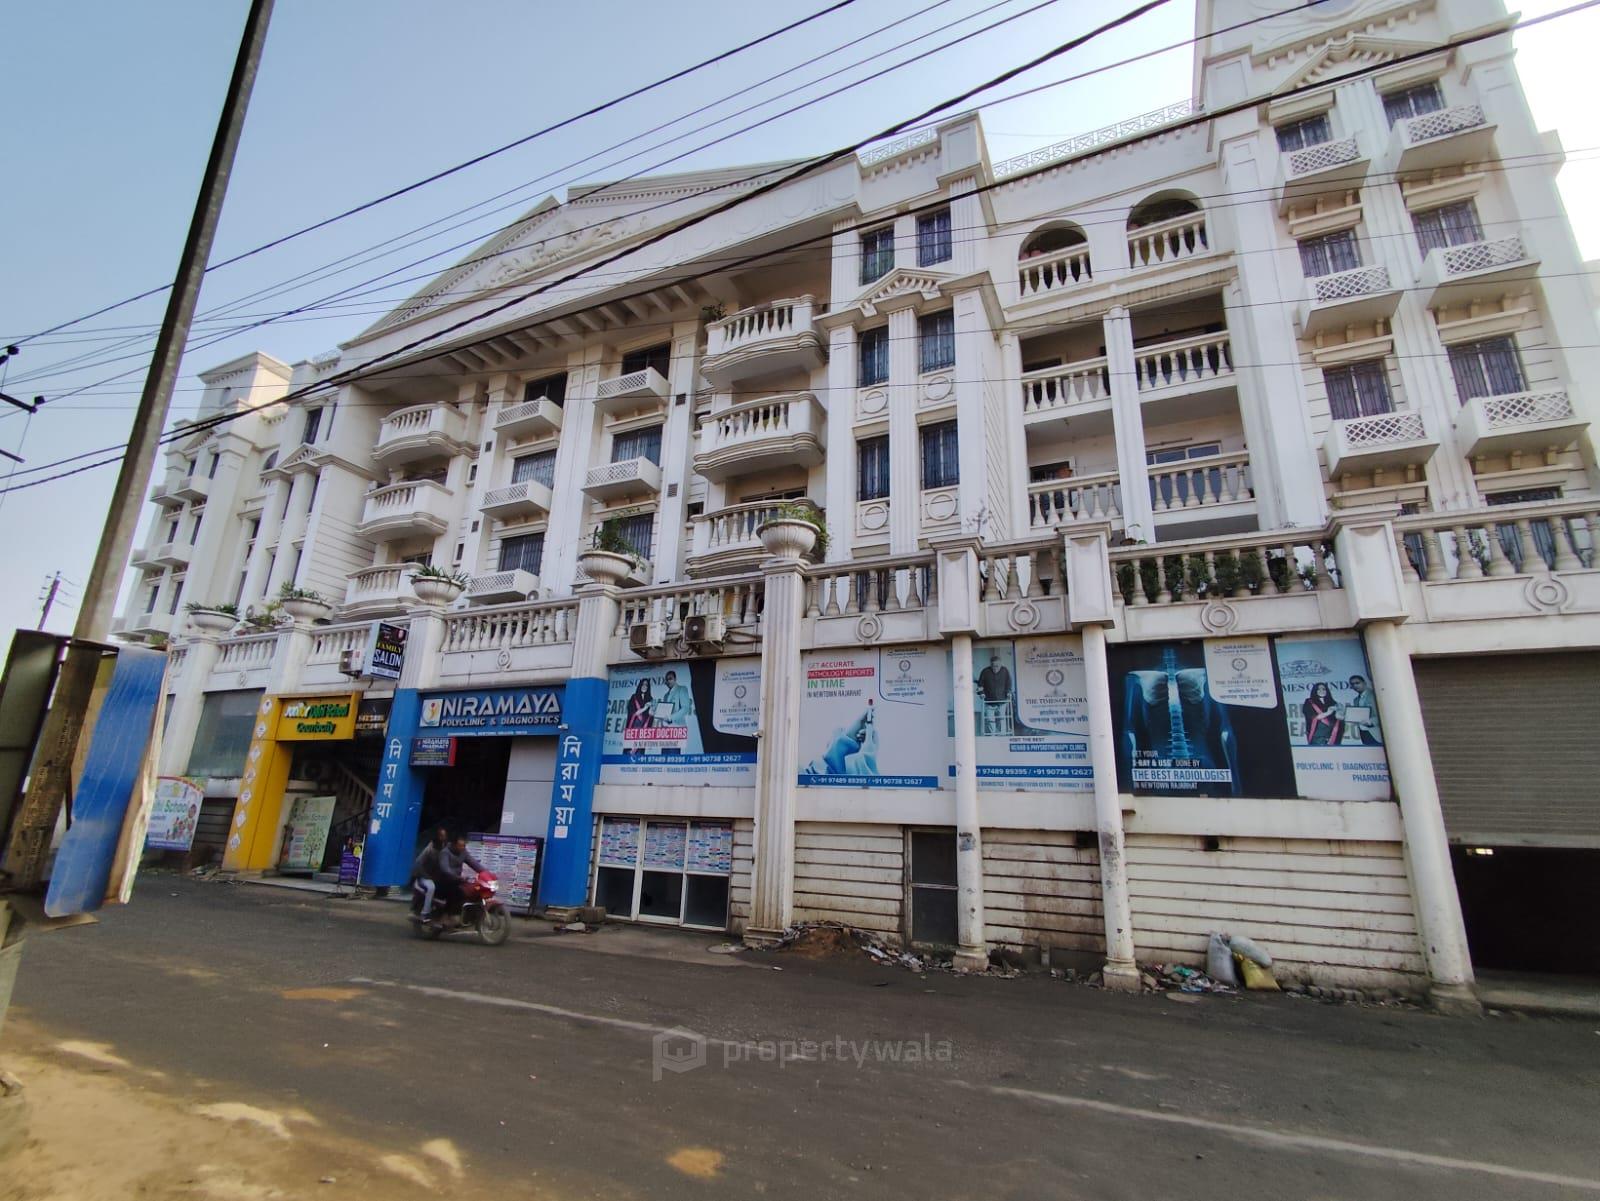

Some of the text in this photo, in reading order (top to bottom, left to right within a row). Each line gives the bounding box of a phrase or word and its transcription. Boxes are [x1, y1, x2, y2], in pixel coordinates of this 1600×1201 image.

[374, 649, 401, 667] SALON
[821, 660, 855, 668] ACCURATE
[808, 668, 873, 678] PATHOLOGY REPORTS
[808, 679, 845, 688] IN TIME
[443, 693, 560, 716] NIRAMAYA
[441, 718, 485, 726] POLYCLINIC
[501, 716, 560, 725] DIAGNOSTICS
[626, 727, 687, 739] GET BEST DOCTORS
[1143, 750, 1158, 758] YOUR
[1175, 759, 1191, 767] DONE
[1296, 762, 1334, 770] POLYCLINIC
[1133, 769, 1230, 780] THE BEST RADIOLOGIST
